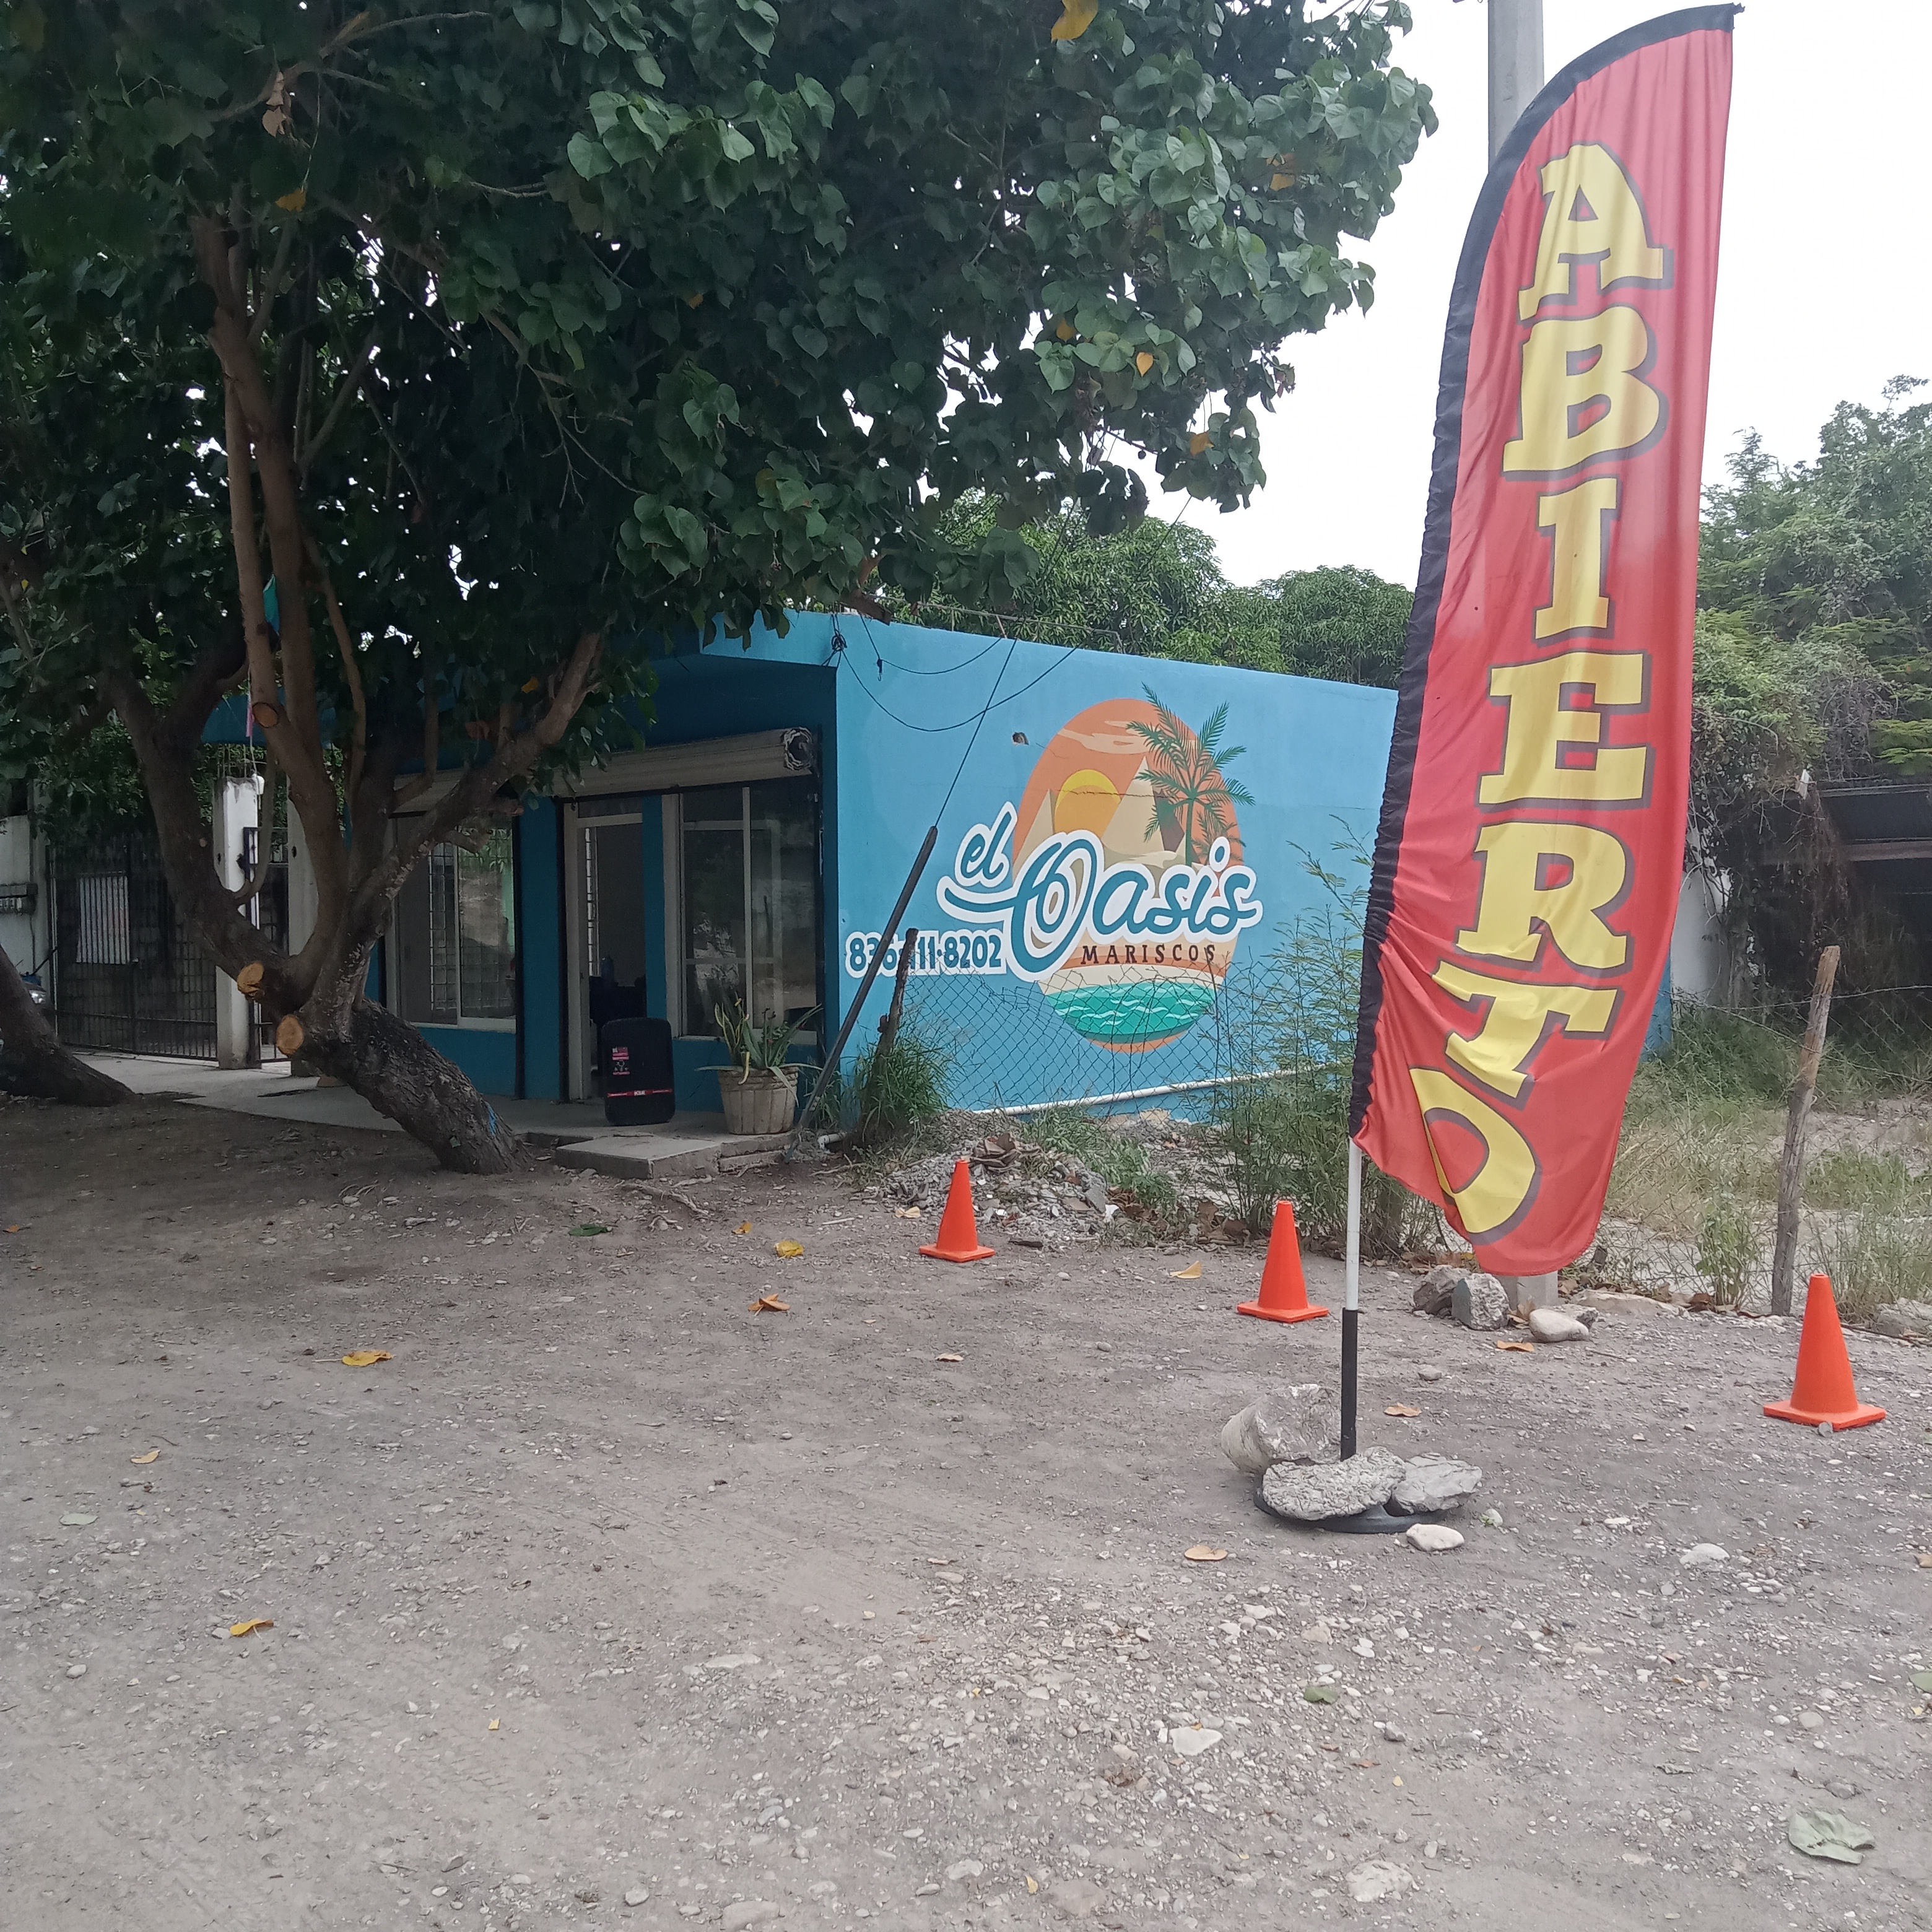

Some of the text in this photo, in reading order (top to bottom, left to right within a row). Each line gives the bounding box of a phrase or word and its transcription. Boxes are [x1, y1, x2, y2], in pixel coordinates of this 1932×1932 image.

[1408, 142, 1669, 1238] ABIERTO
[959, 809, 1013, 881] el
[943, 837, 1258, 974] Oasis
[1080, 943, 1216, 965] MARISCOS
